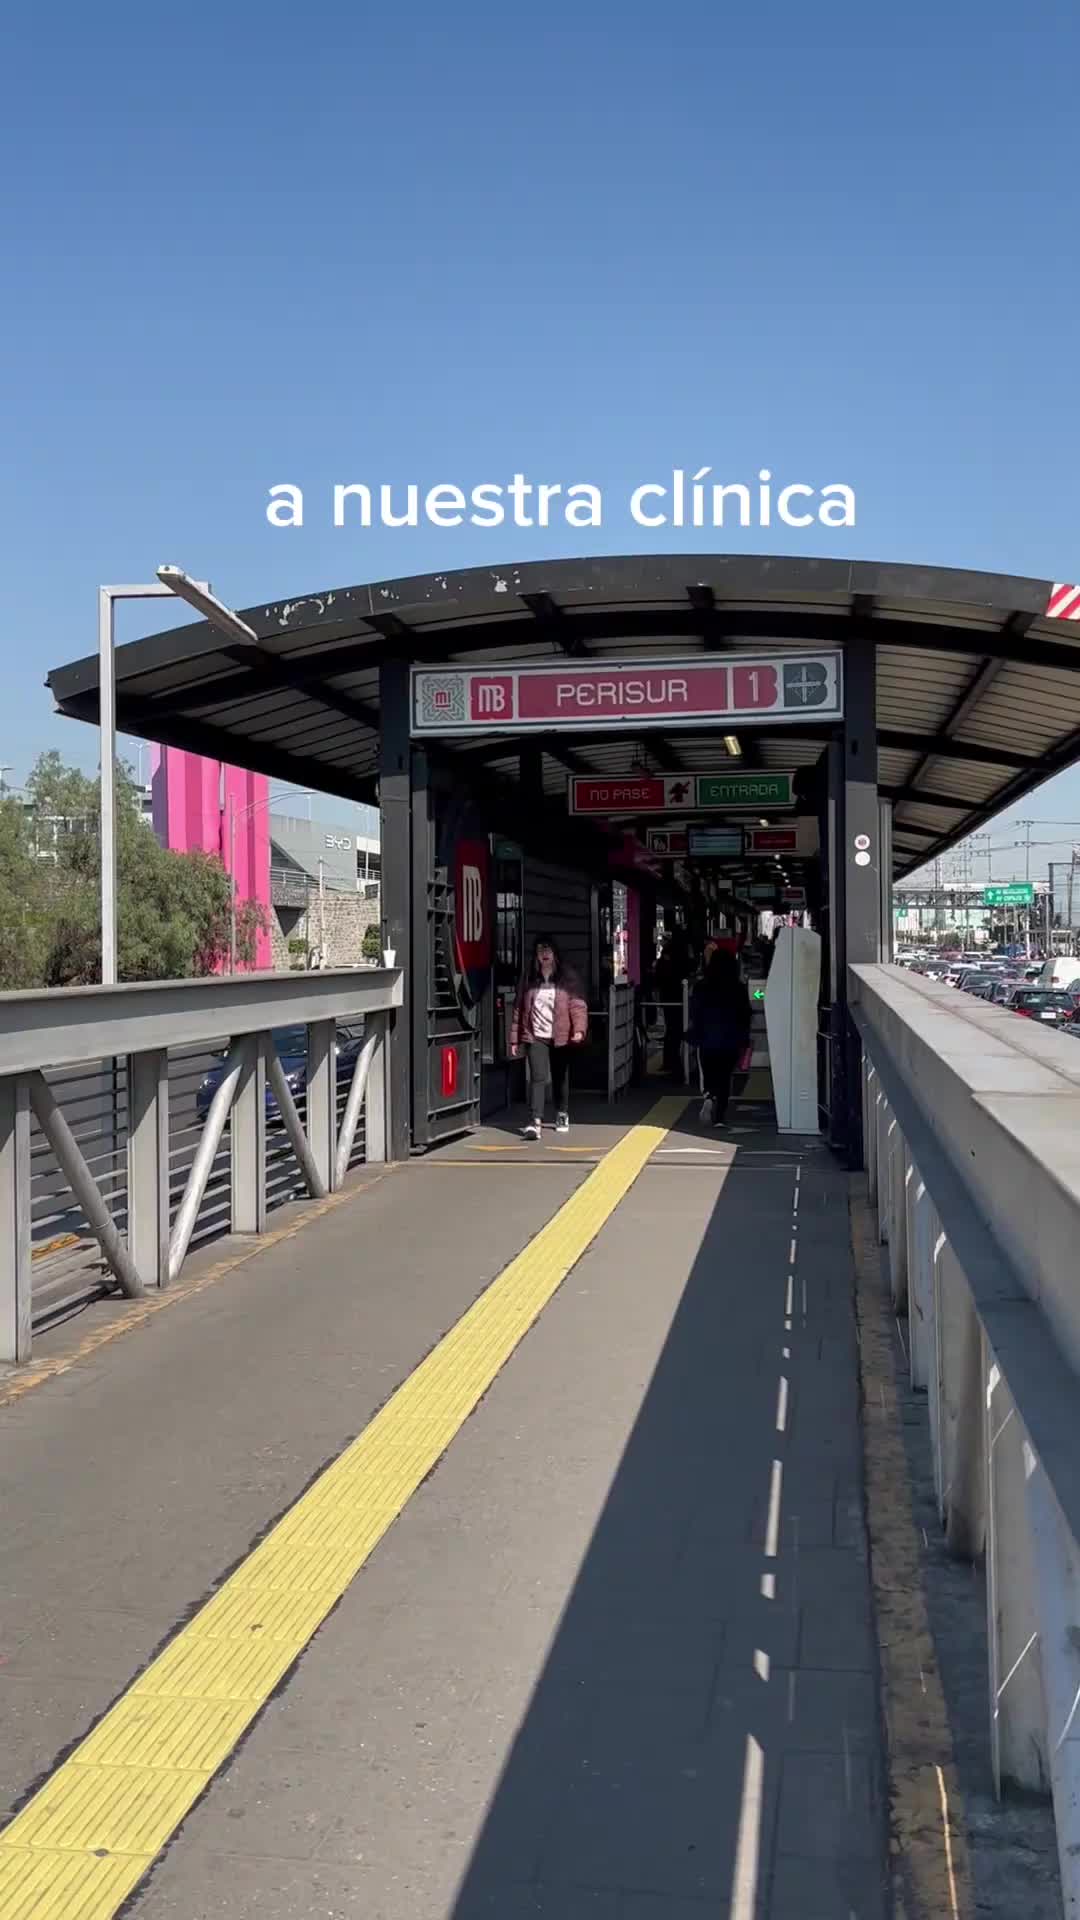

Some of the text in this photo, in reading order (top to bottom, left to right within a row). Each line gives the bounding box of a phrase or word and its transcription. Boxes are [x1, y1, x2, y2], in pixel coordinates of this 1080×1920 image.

[556, 679, 688, 707] PERISUR
[748, 671, 759, 702] 1
[590, 787, 650, 801] NO PASE
[710, 783, 780, 797] ENTRADA
